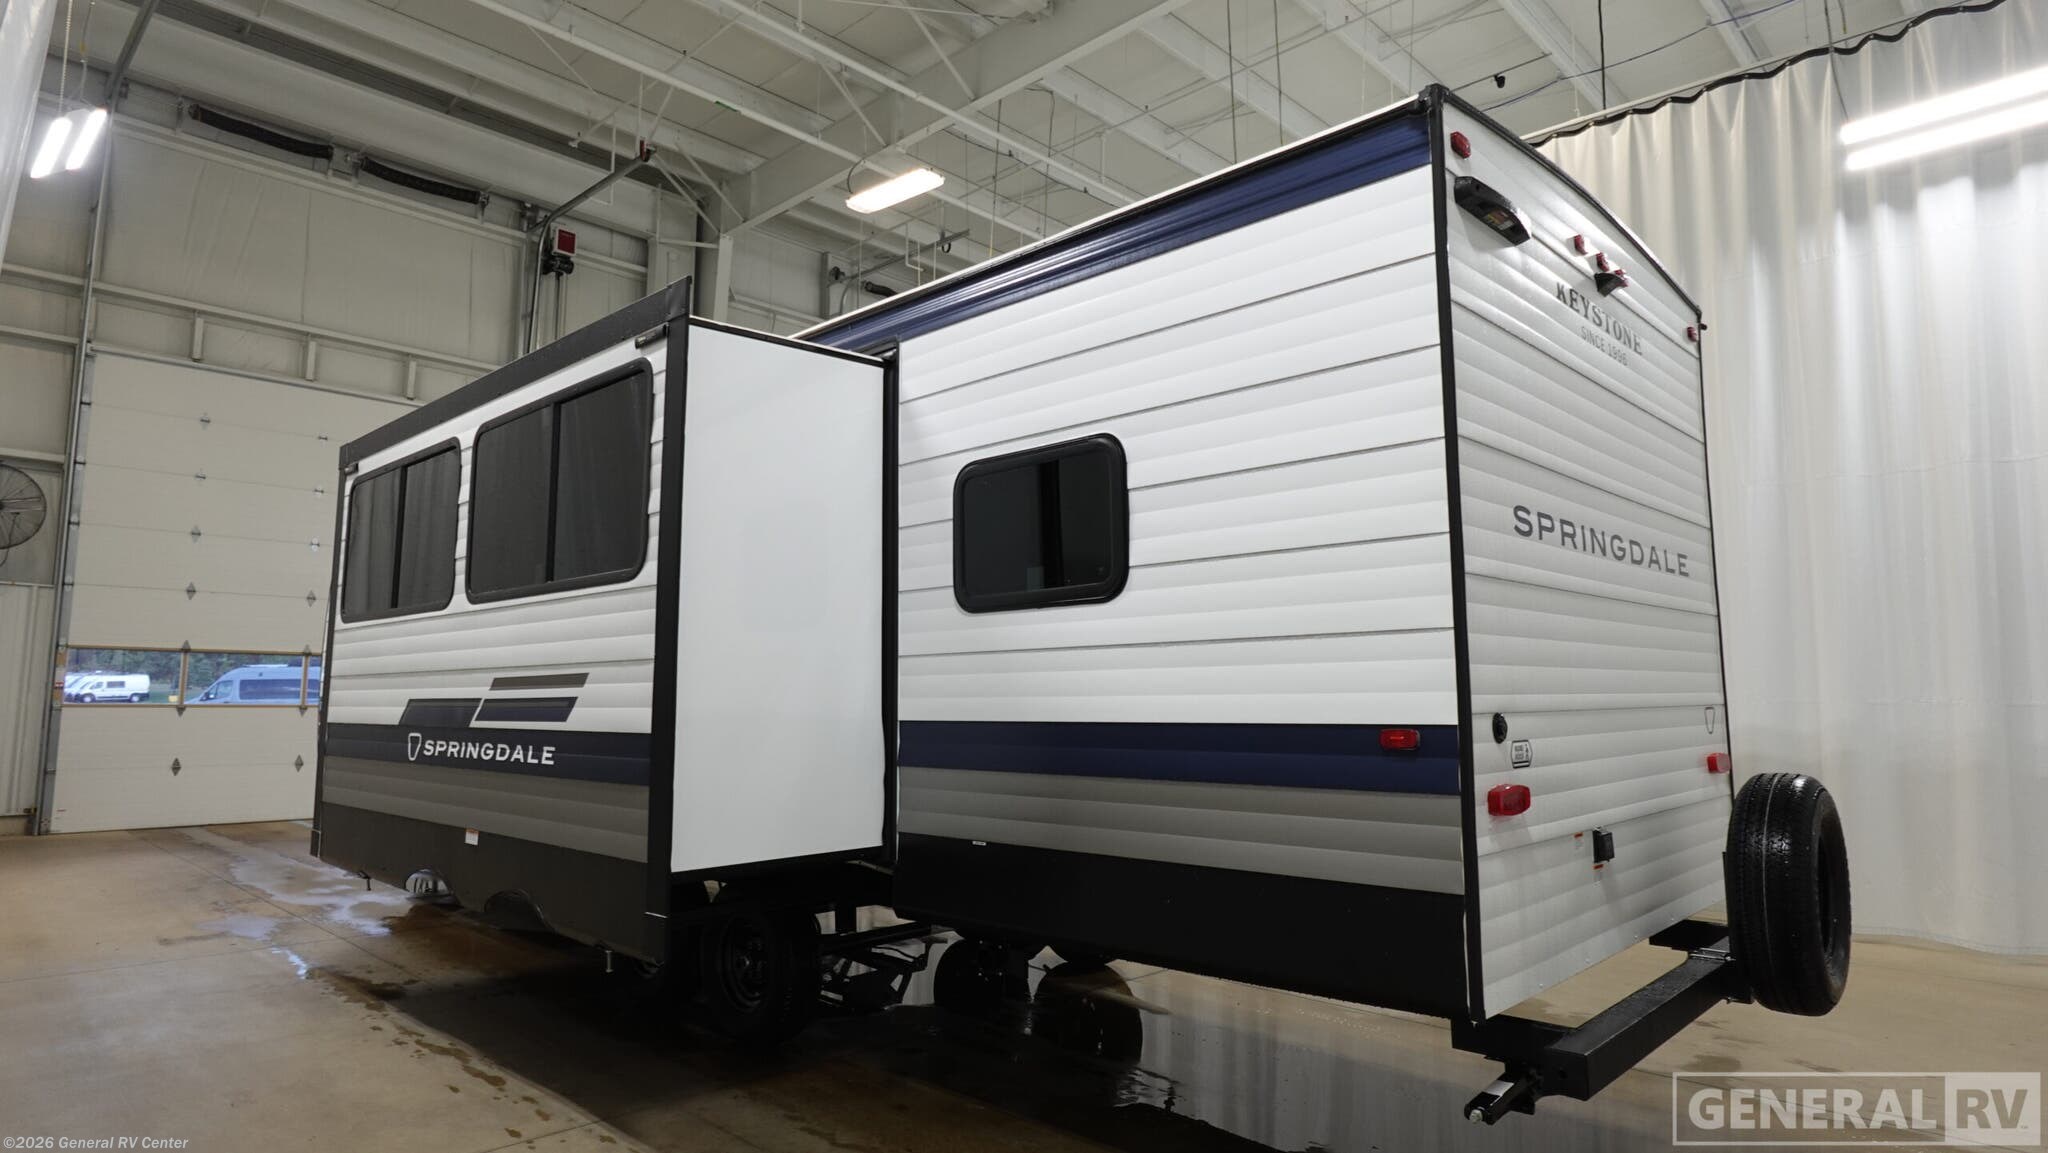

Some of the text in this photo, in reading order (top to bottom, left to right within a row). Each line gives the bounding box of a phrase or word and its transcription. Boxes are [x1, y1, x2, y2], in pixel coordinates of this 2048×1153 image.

[1556, 282, 1642, 356] KEYSTONE
[1581, 326, 1605, 352] SINCE
[1513, 505, 1689, 577] SPRINGDALE
[423, 740, 555, 765] SPRINGDALE
